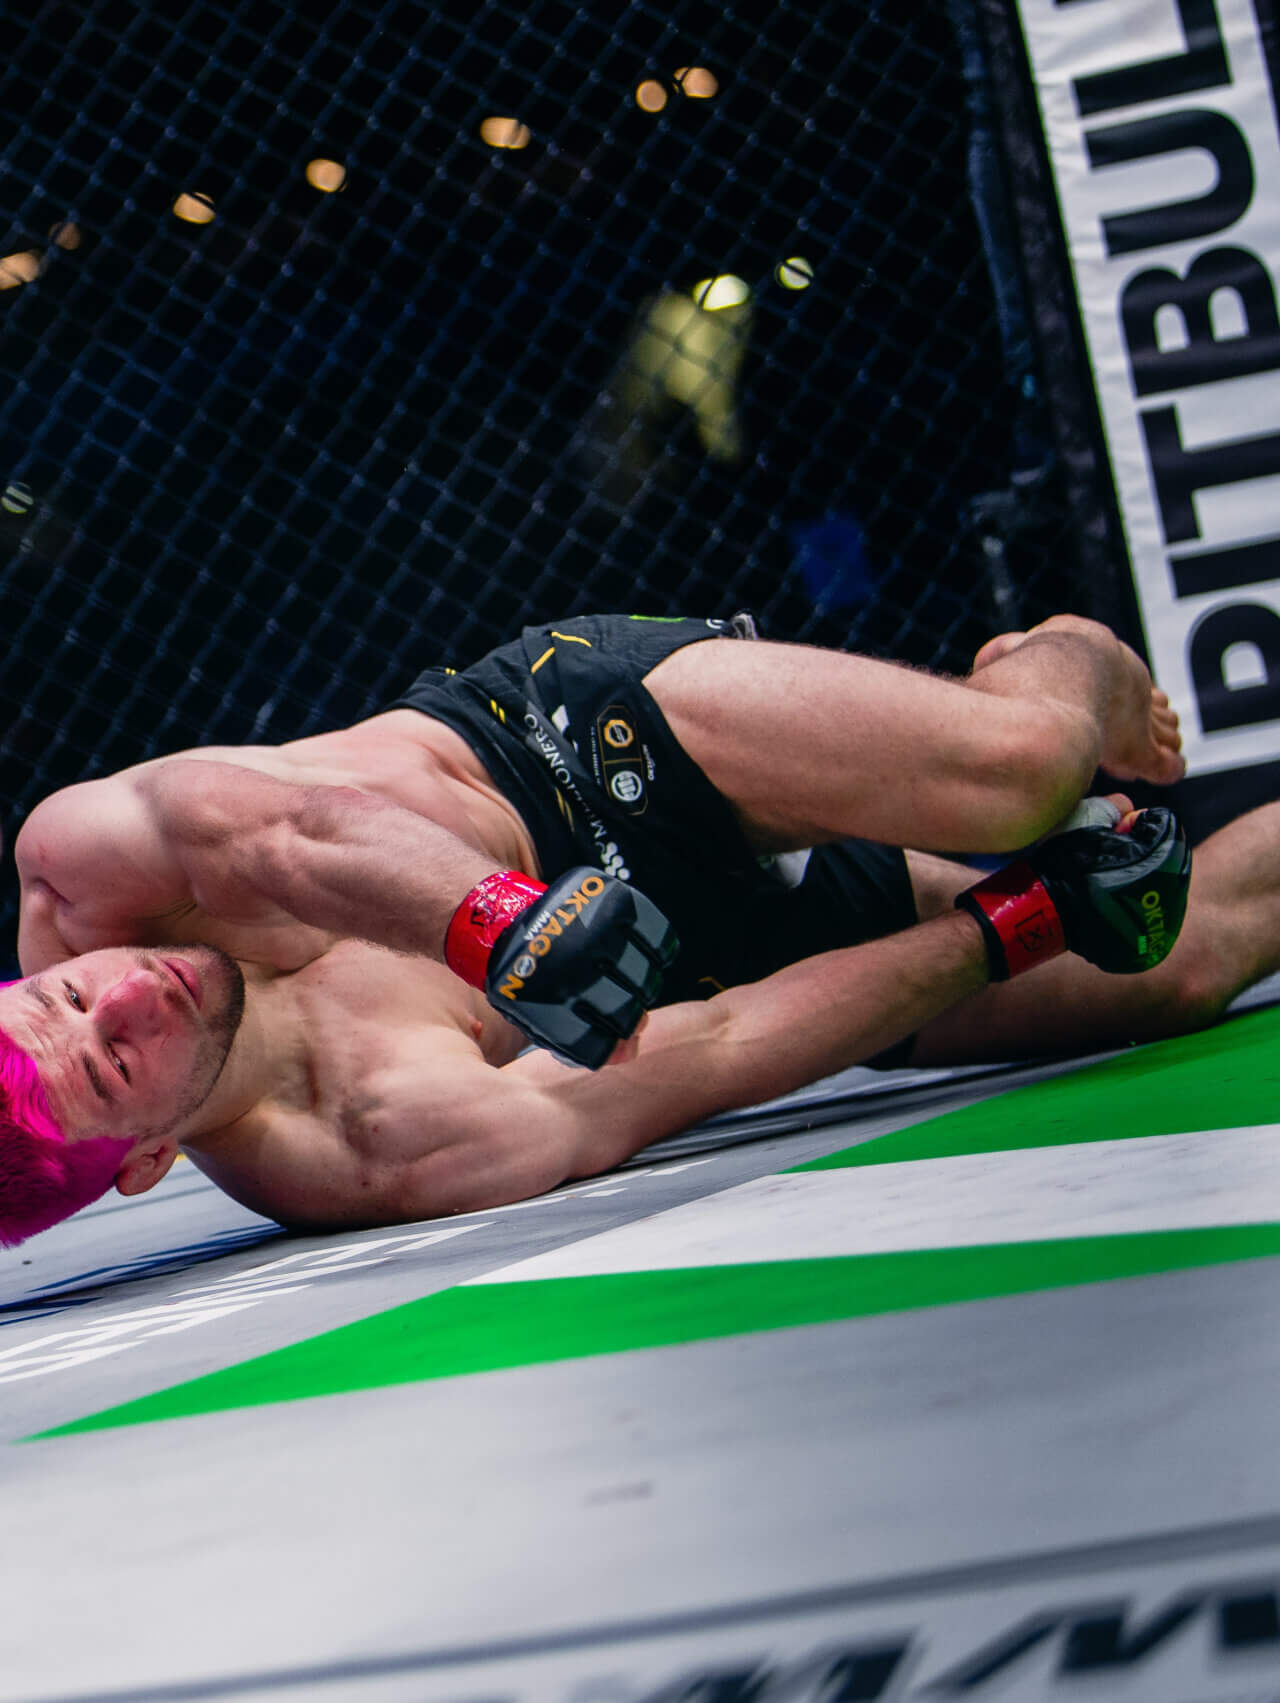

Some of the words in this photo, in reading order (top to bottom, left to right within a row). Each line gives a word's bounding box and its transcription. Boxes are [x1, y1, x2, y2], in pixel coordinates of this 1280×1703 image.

[1055, 0, 1280, 735] PITBUL
[523, 712, 608, 839] MIONERO
[498, 876, 605, 1001] OKTAGON
[523, 910, 552, 942] MMA
[1141, 890, 1166, 966] OKTAG
